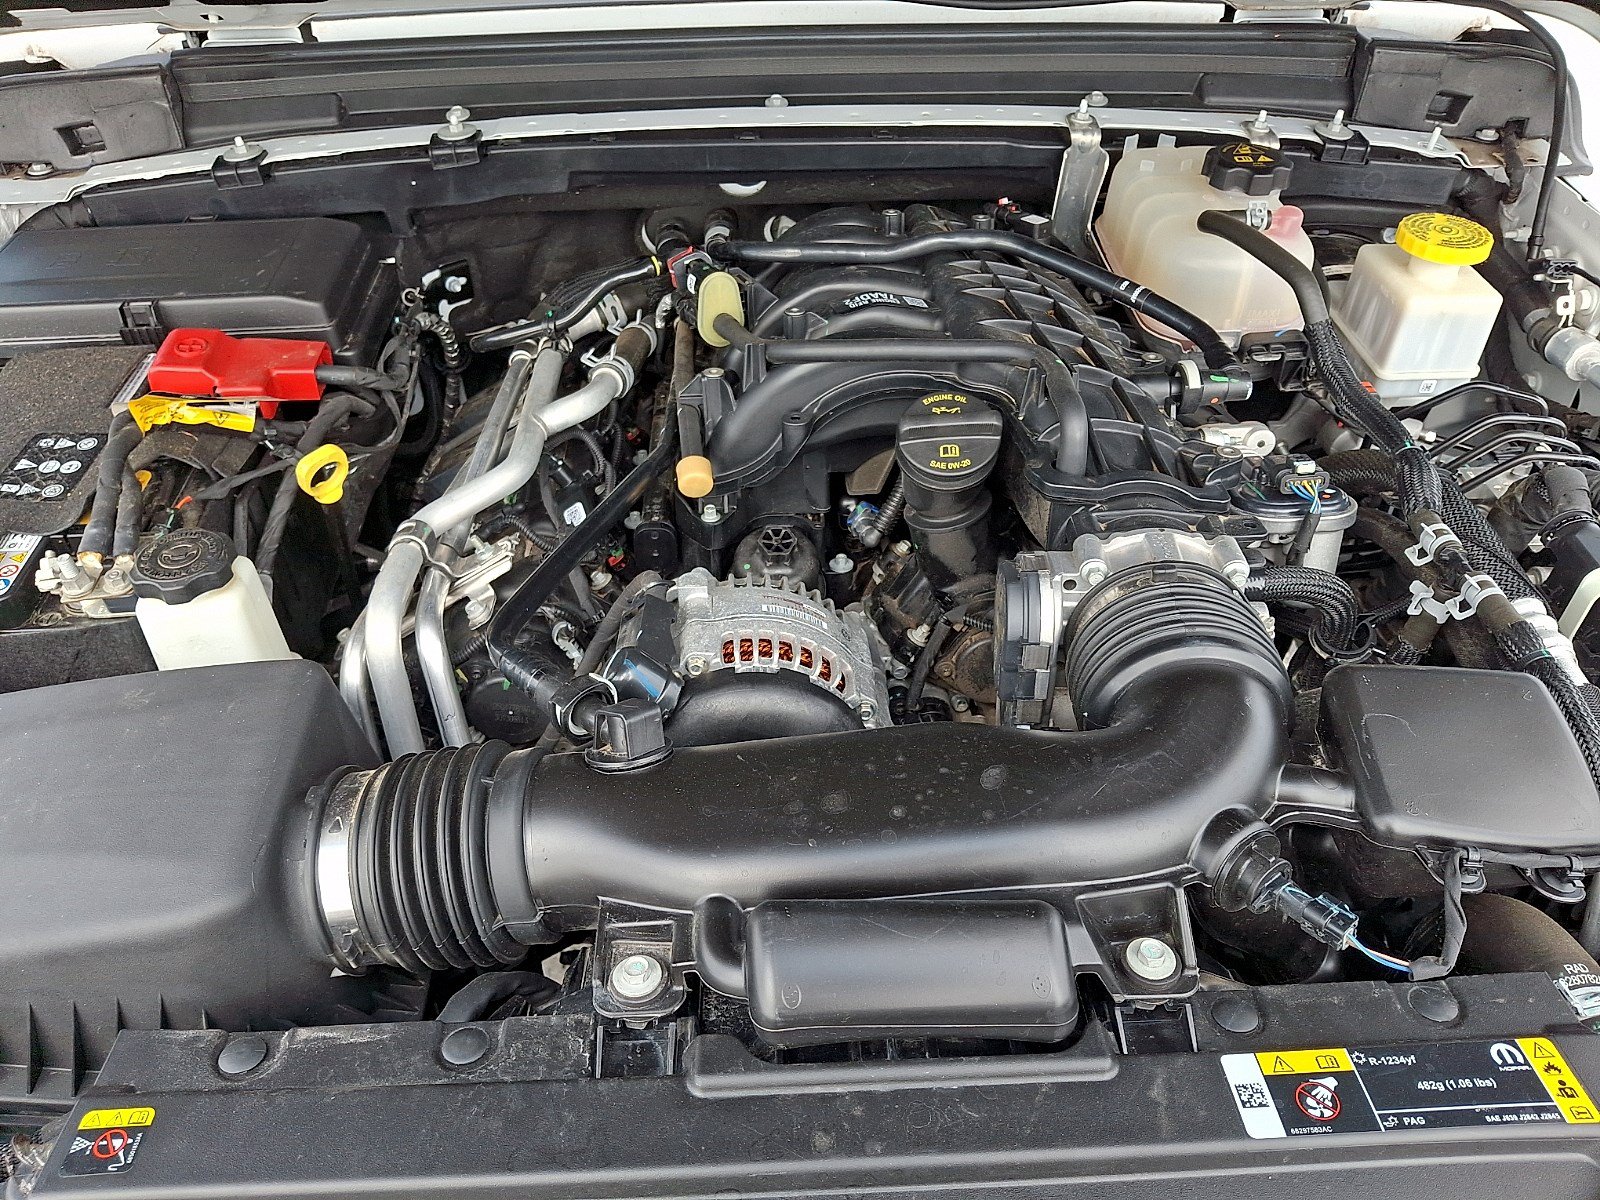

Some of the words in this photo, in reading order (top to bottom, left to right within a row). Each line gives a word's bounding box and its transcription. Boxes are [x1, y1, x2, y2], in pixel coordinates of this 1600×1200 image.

[922, 394, 953, 406] ENGINE
[954, 395, 967, 404] OIL
[929, 460, 947, 470] SAE
[947, 458, 972, 470] 0W-20
[1563, 963, 1590, 975] RAD
[1368, 1054, 1417, 1066] R-1234yf
[1417, 1080, 1446, 1092] 482g
[1445, 1078, 1474, 1091] (1.06
[1473, 1077, 1498, 1089] lbs)
[1402, 1116, 1426, 1126] PAG
